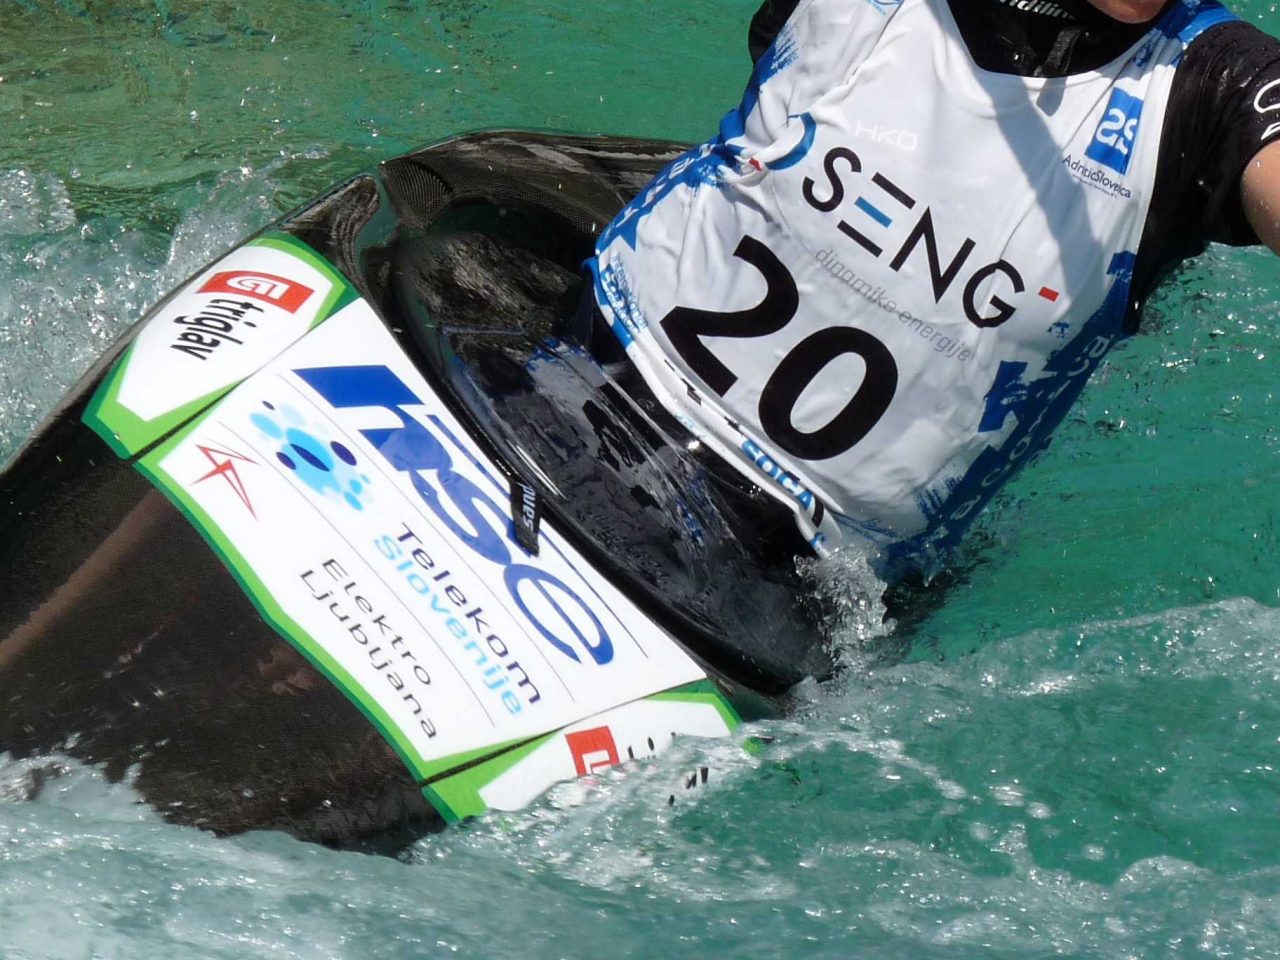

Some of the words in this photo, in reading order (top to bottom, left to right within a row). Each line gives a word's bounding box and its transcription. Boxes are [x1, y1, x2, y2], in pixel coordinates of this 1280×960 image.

[802, 146, 1025, 329] SENG
[170, 298, 264, 361] triglav
[659, 234, 898, 461] 20
[899, 307, 973, 363] energije
[300, 568, 437, 739] Ljubljana
[322, 558, 431, 686] Elektro
[374, 533, 522, 715] Slovenije
[396, 522, 541, 705] Telekom
